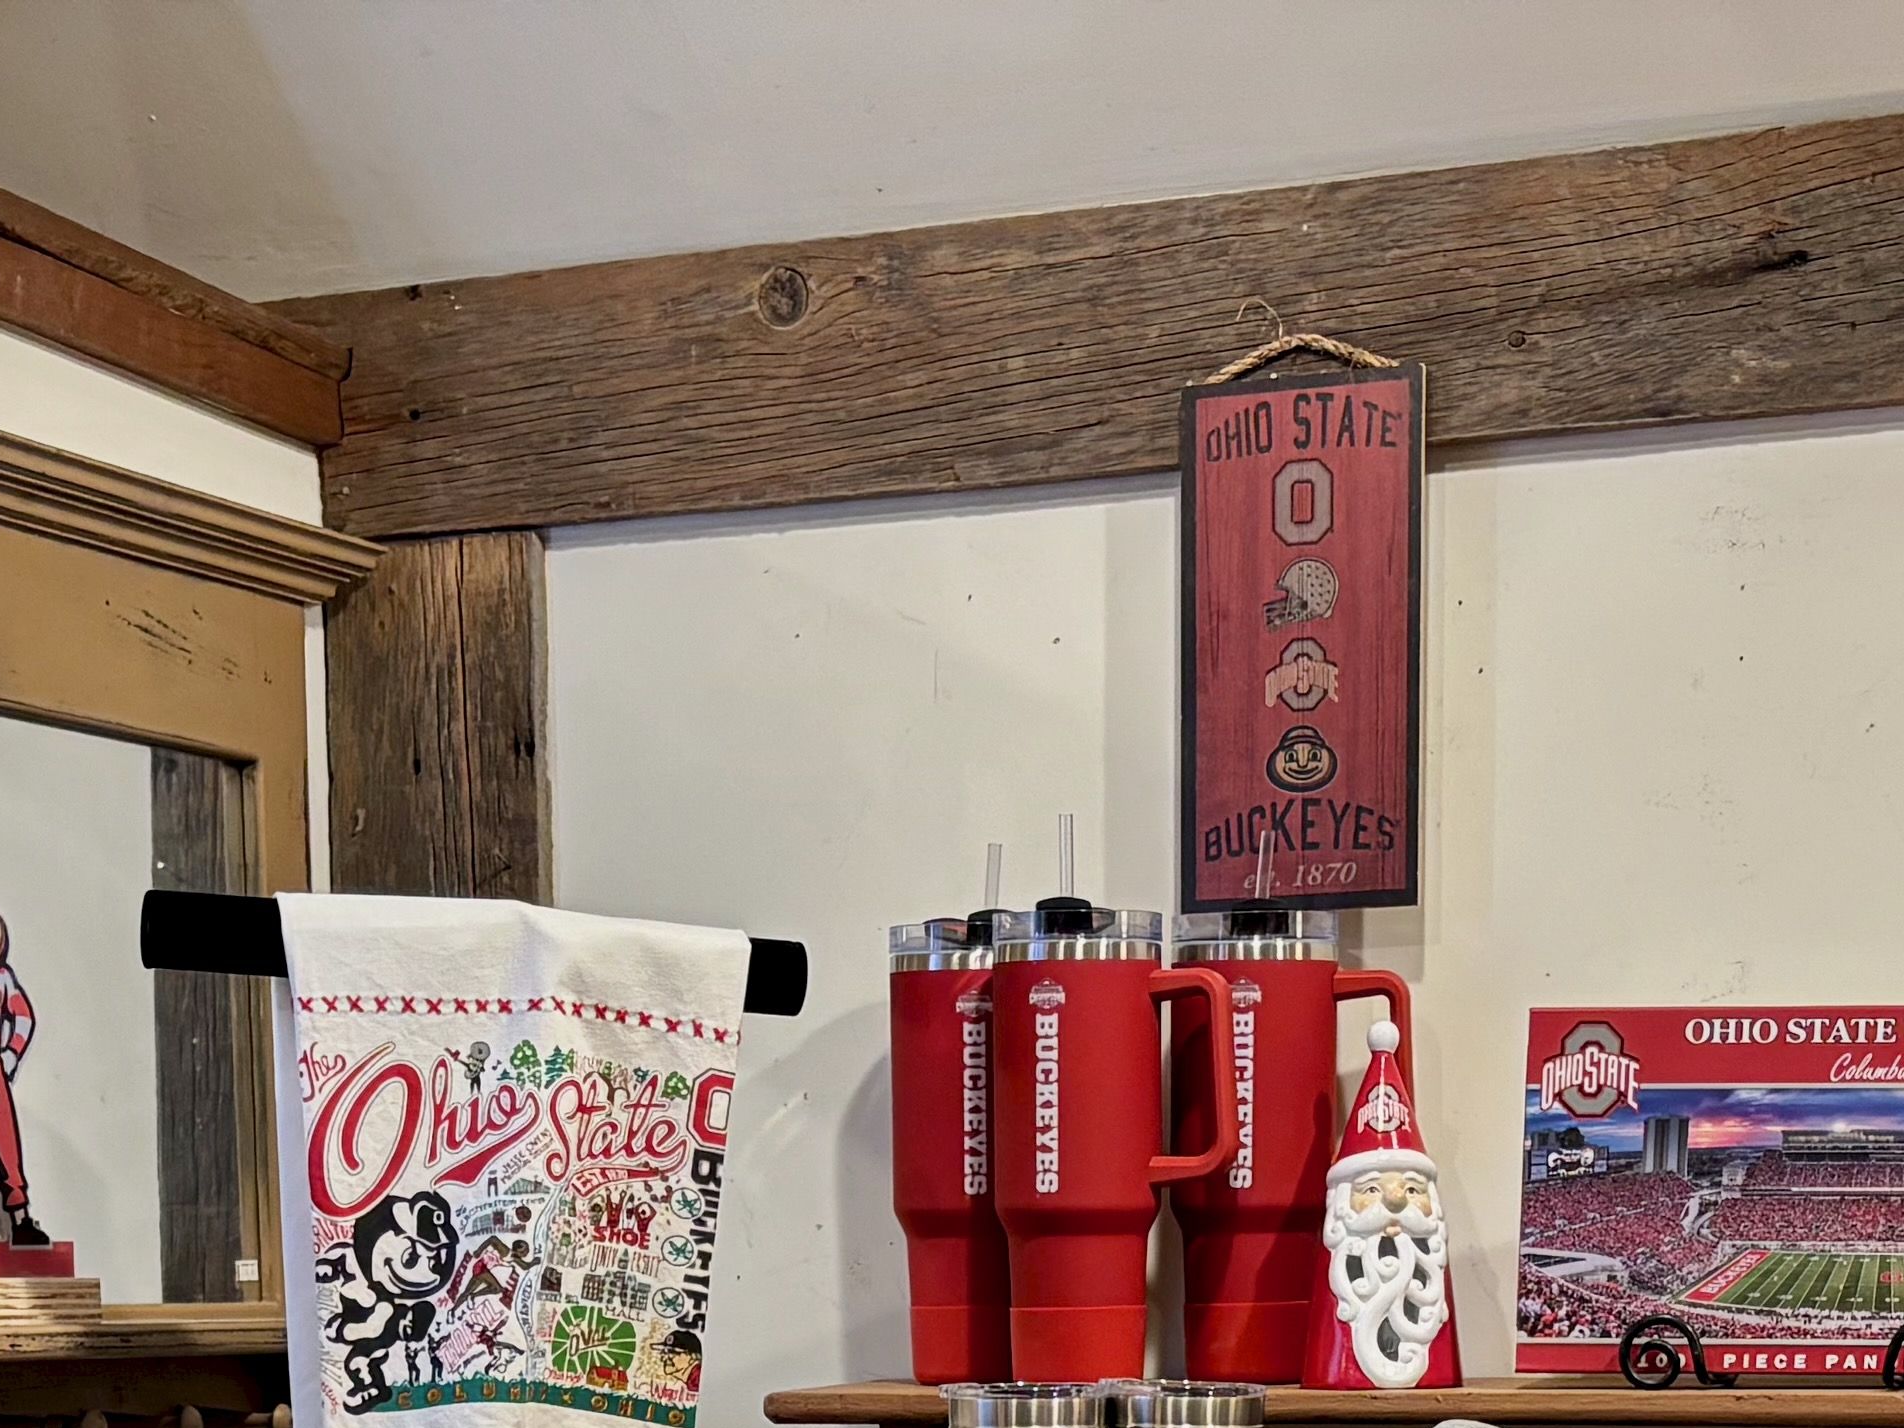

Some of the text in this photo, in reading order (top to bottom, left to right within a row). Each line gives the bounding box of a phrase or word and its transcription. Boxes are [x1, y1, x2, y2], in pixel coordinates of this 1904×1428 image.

[1205, 392, 1400, 463] OHIO STATE
[1204, 797, 1401, 862] BUCKEYES
[1292, 860, 1358, 888] 1870
[1685, 1016, 1781, 1048] OHIO
[1785, 1016, 1899, 1047] STATE
[308, 1040, 543, 1222] Ohio
[546, 1071, 690, 1184] State
[961, 1019, 987, 1197] BUCKEYES
[1033, 1010, 1060, 1196] BUCKEYES
[1228, 1009, 1257, 1191] BUCKEYES
[593, 1225, 651, 1251] SHOE
[1723, 1354, 1808, 1370] PIECE
